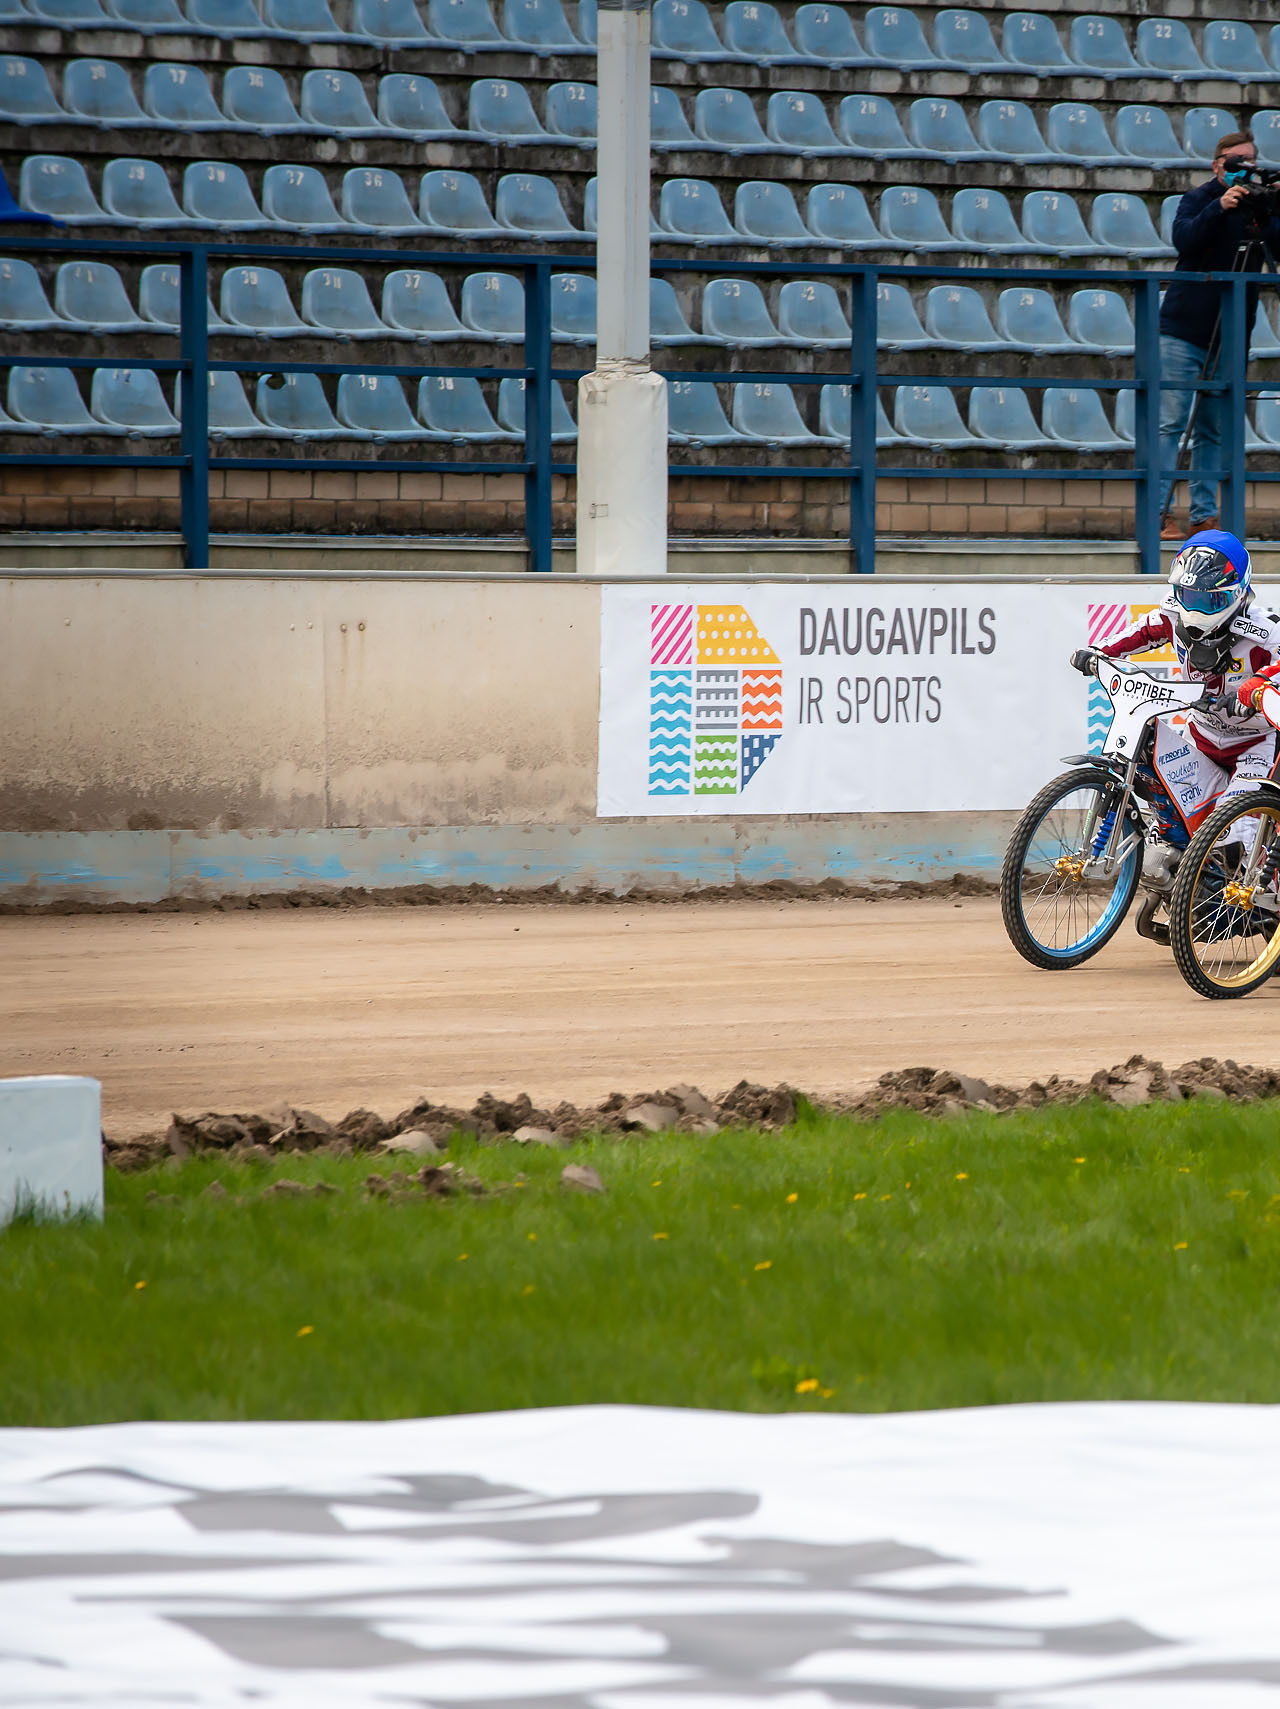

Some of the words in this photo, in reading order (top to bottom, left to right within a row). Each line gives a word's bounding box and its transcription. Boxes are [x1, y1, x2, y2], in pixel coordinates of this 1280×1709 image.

[883, 12, 899, 26] 26
[954, 15, 969, 31] 25
[1087, 22, 1104, 37] 23
[1155, 24, 1172, 39] 22
[1221, 26, 1236, 41] 21
[568, 86, 585, 100] 32
[365, 172, 382, 186] 36
[405, 274, 421, 288] 37
[799, 607, 996, 656] DAUGAVPILS
[1124, 679, 1175, 703] OPTIBET
[799, 677, 824, 724] IR
[836, 676, 942, 724] SPORTS
